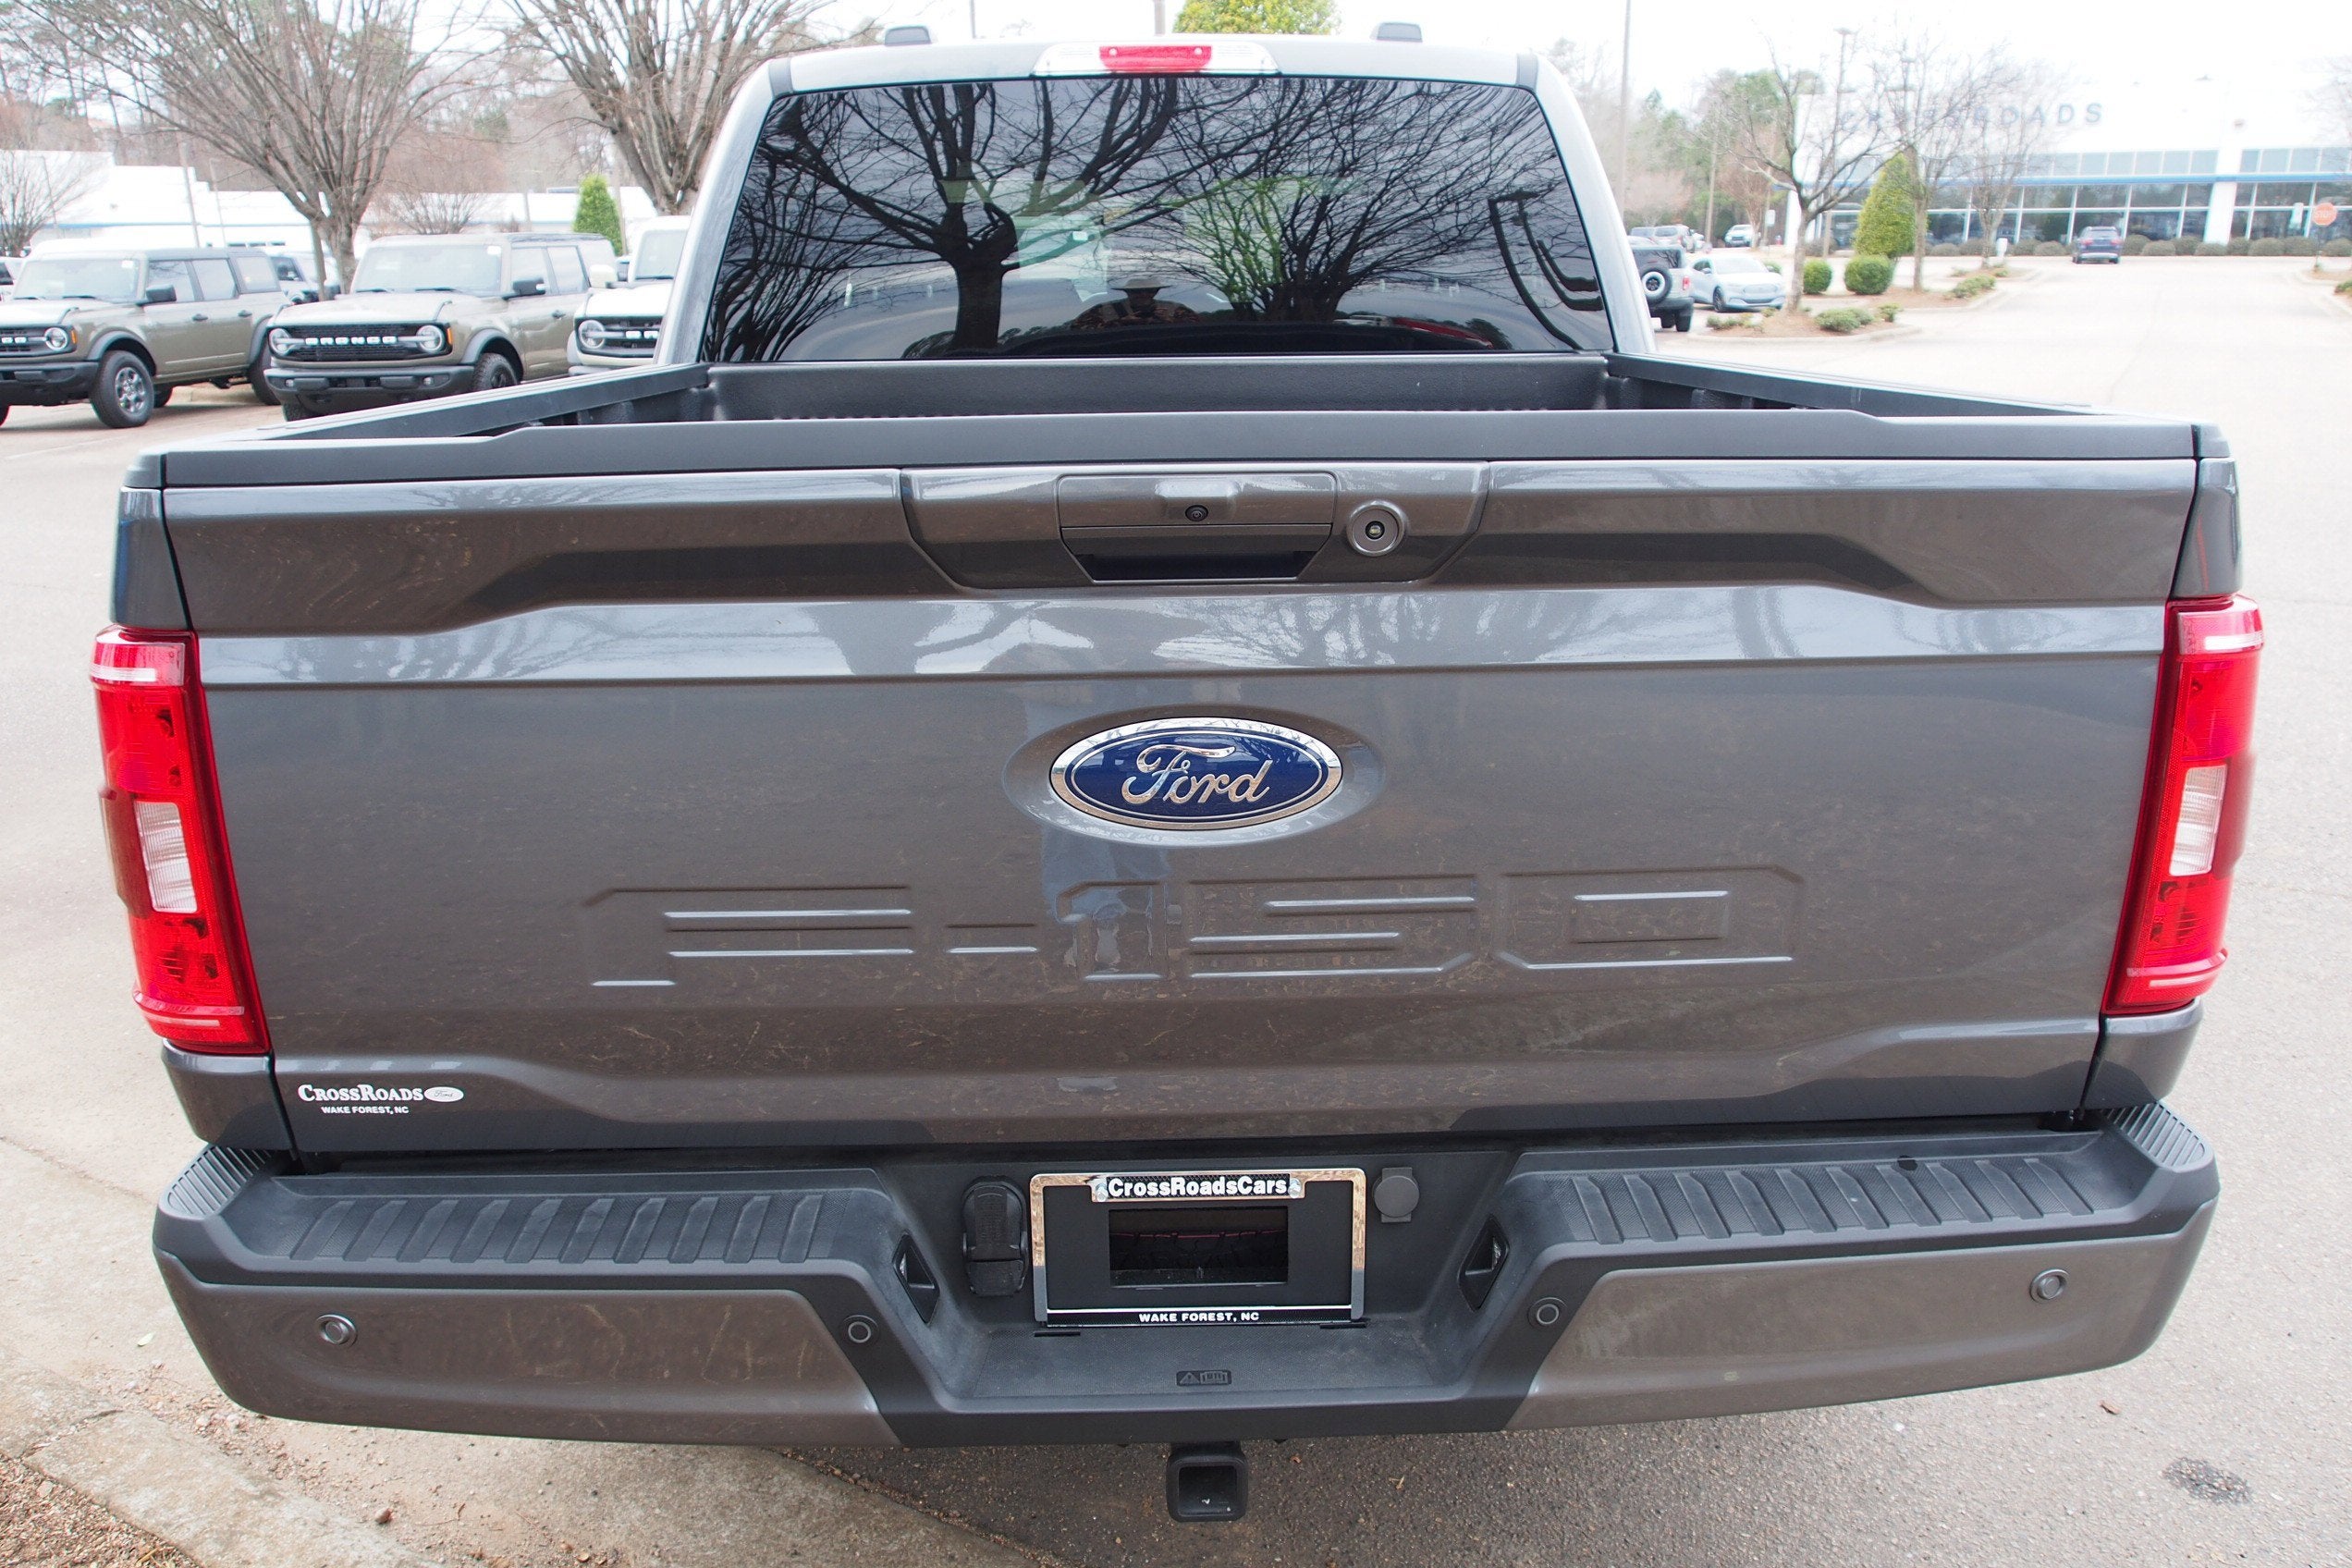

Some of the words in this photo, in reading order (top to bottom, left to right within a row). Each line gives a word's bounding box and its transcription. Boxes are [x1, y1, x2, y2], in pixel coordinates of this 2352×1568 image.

[305, 336, 398, 346] BRONCO
[1121, 744, 1274, 804] Ford
[584, 864, 1804, 988] F-150
[321, 1106, 351, 1114] WAKE
[352, 1106, 394, 1115] FOREST,
[395, 1106, 410, 1114] NC
[1108, 1175, 1287, 1197] CrossRoadsCars
[1138, 1313, 1178, 1323] WAKE
[1181, 1312, 1237, 1323] FOREST,
[1241, 1311, 1259, 1321] NC
